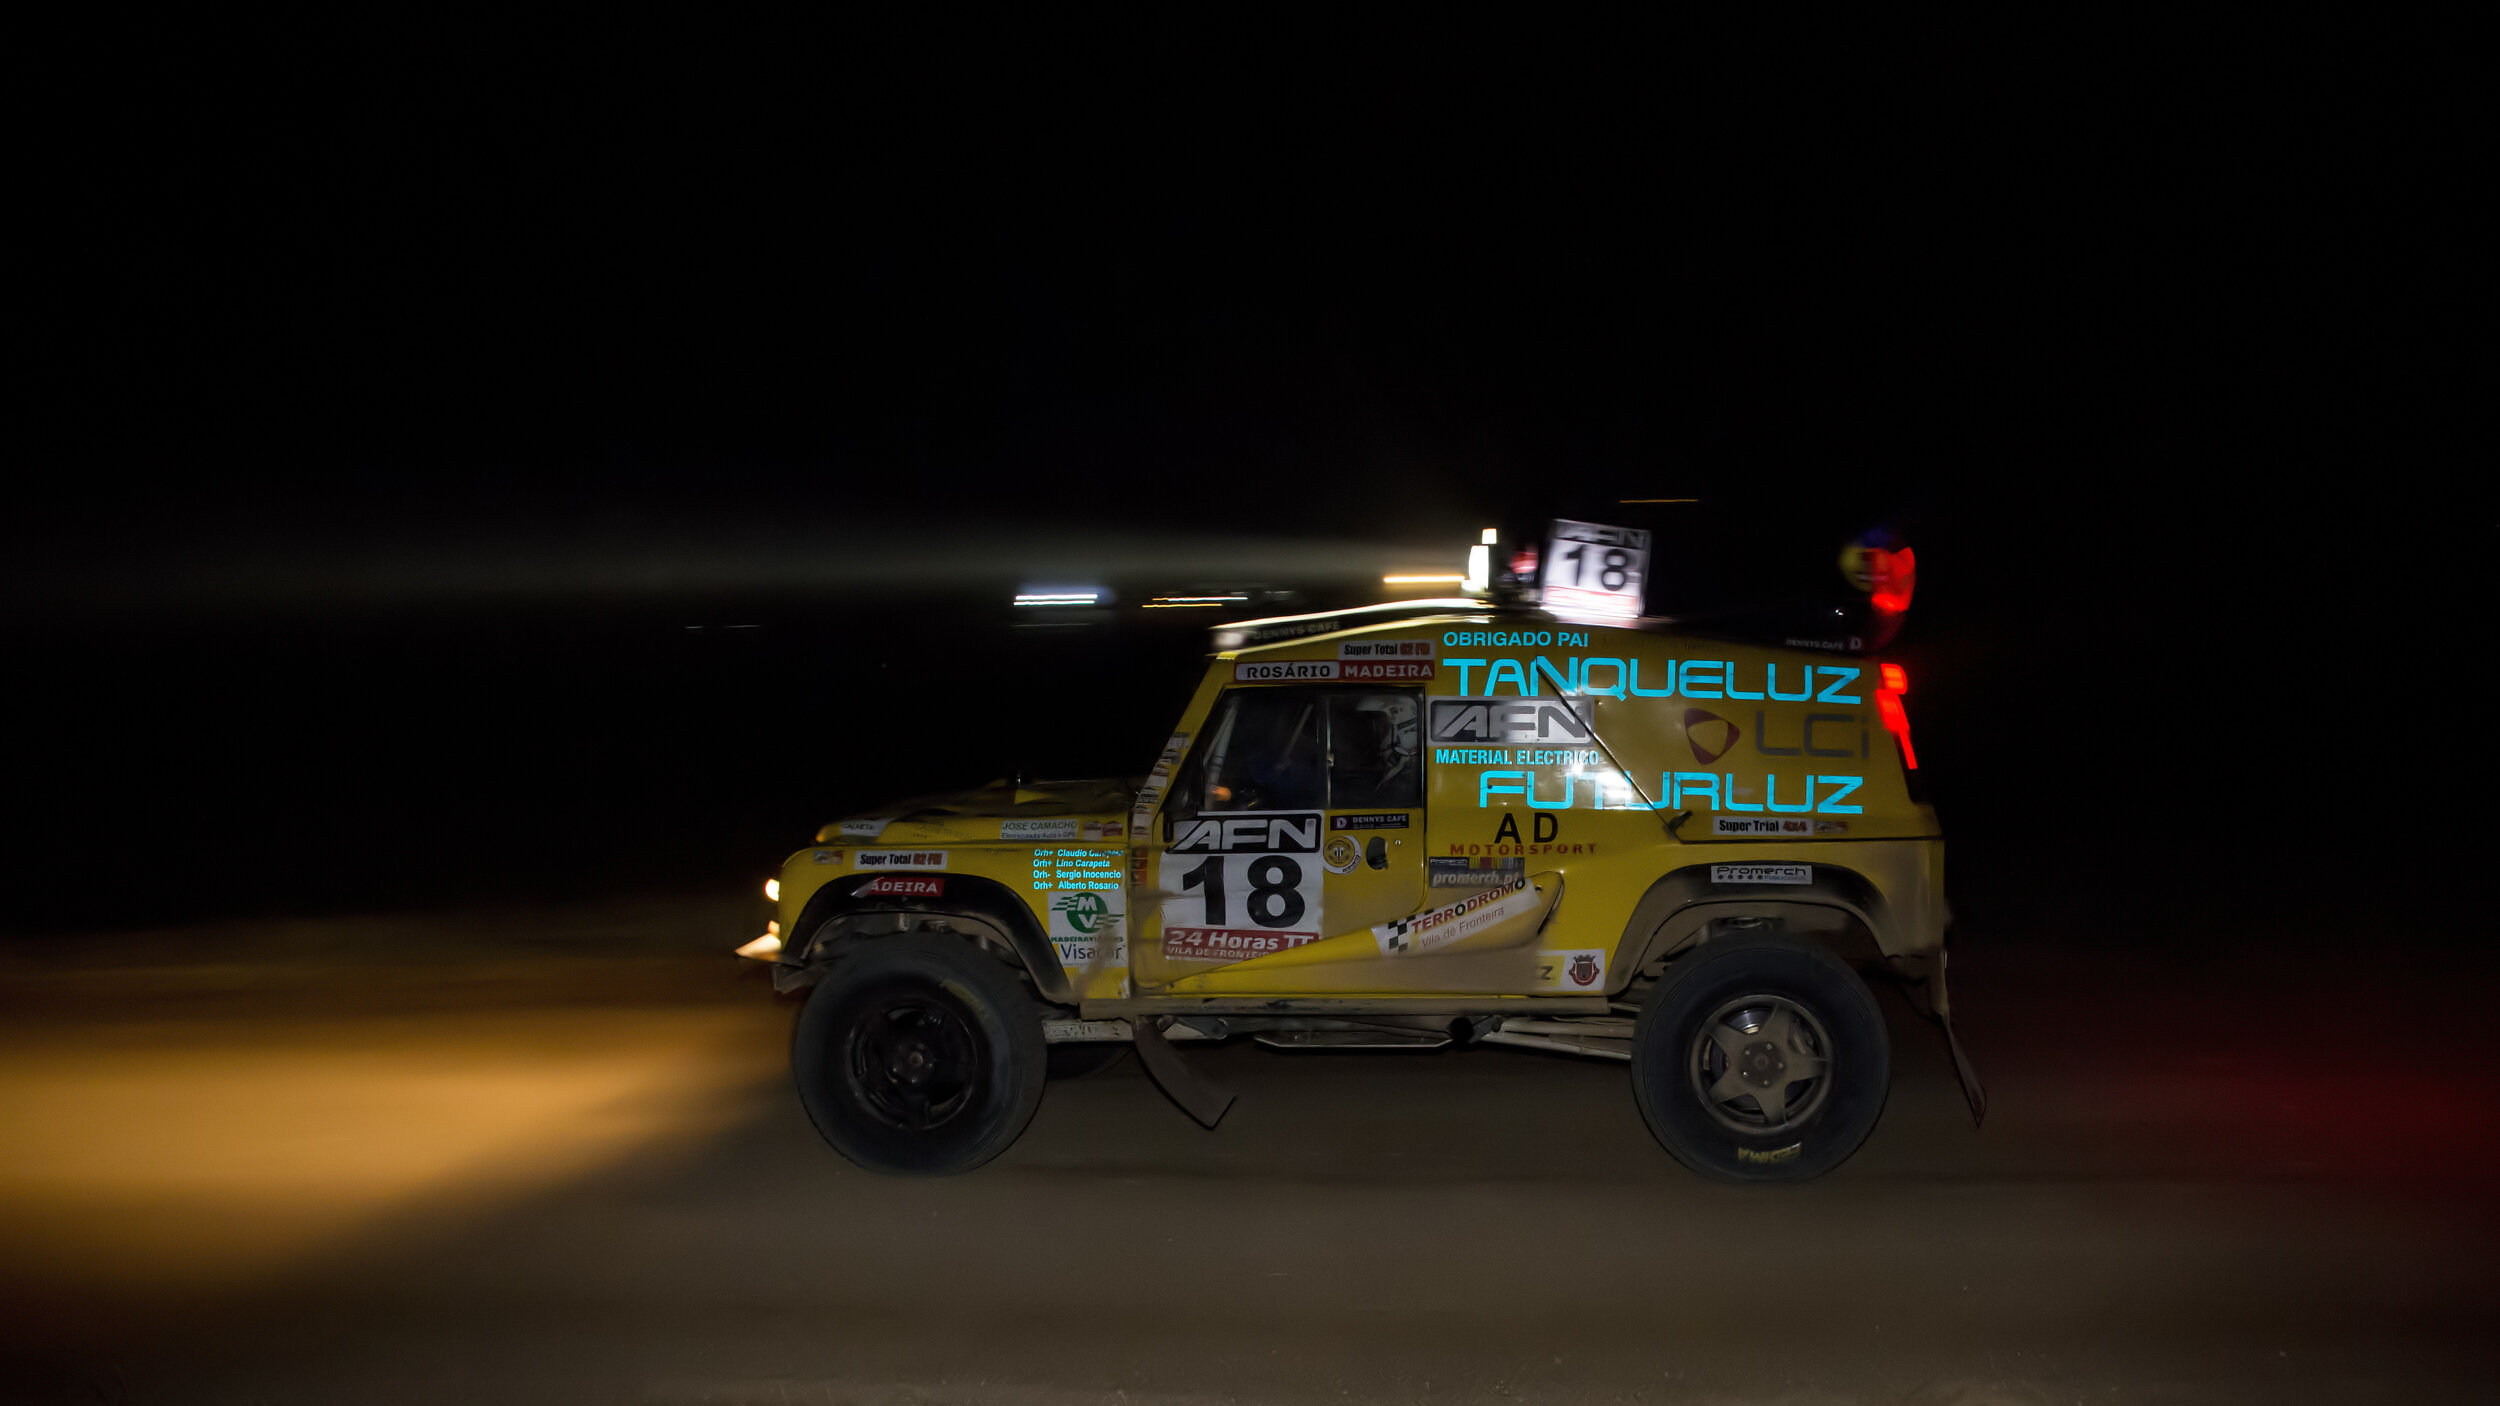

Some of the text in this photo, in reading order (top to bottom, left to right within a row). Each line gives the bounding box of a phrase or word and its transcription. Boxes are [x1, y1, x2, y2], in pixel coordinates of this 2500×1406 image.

[1563, 545, 1628, 591] 18
[1443, 631, 1588, 647] OBRIGADO PAI
[1344, 644, 1371, 656] Super
[1375, 643, 1398, 655] Total
[1247, 662, 1433, 678] ROSÁRIO MADEIRA
[1443, 655, 1861, 704] TANQUELUZ
[1434, 705, 1587, 738] AFN
[1435, 749, 1600, 765] MATERIAL ELECTRICO
[1479, 770, 1864, 814] FUTURLUZ
[1030, 820, 1078, 830] CAMACHO
[1335, 816, 1347, 829] D
[1719, 820, 1751, 832] Super
[1754, 820, 1779, 831] Trial
[1173, 818, 1317, 851] AFN
[1057, 848, 1087, 857] Claudio
[1450, 843, 1597, 856] MOTORSPORT
[860, 854, 887, 866] Super
[889, 854, 911, 864] Total
[1056, 859, 1074, 867] Lino
[1075, 859, 1111, 869] Carapeta
[1056, 869, 1081, 880] Sergio
[1083, 869, 1121, 879] Inocencio
[1717, 866, 1806, 876] Promerch
[1057, 880, 1087, 889] Alberto
[1088, 880, 1119, 889] Rosario
[1182, 855, 1305, 928] 18
[1412, 878, 1526, 934] TERRODROMO
[1421, 934, 1441, 948] Vila
[1459, 906, 1505, 932] Fronteira
[1167, 930, 1315, 950] 24 Horas TT
[1168, 947, 1192, 955] VILA
